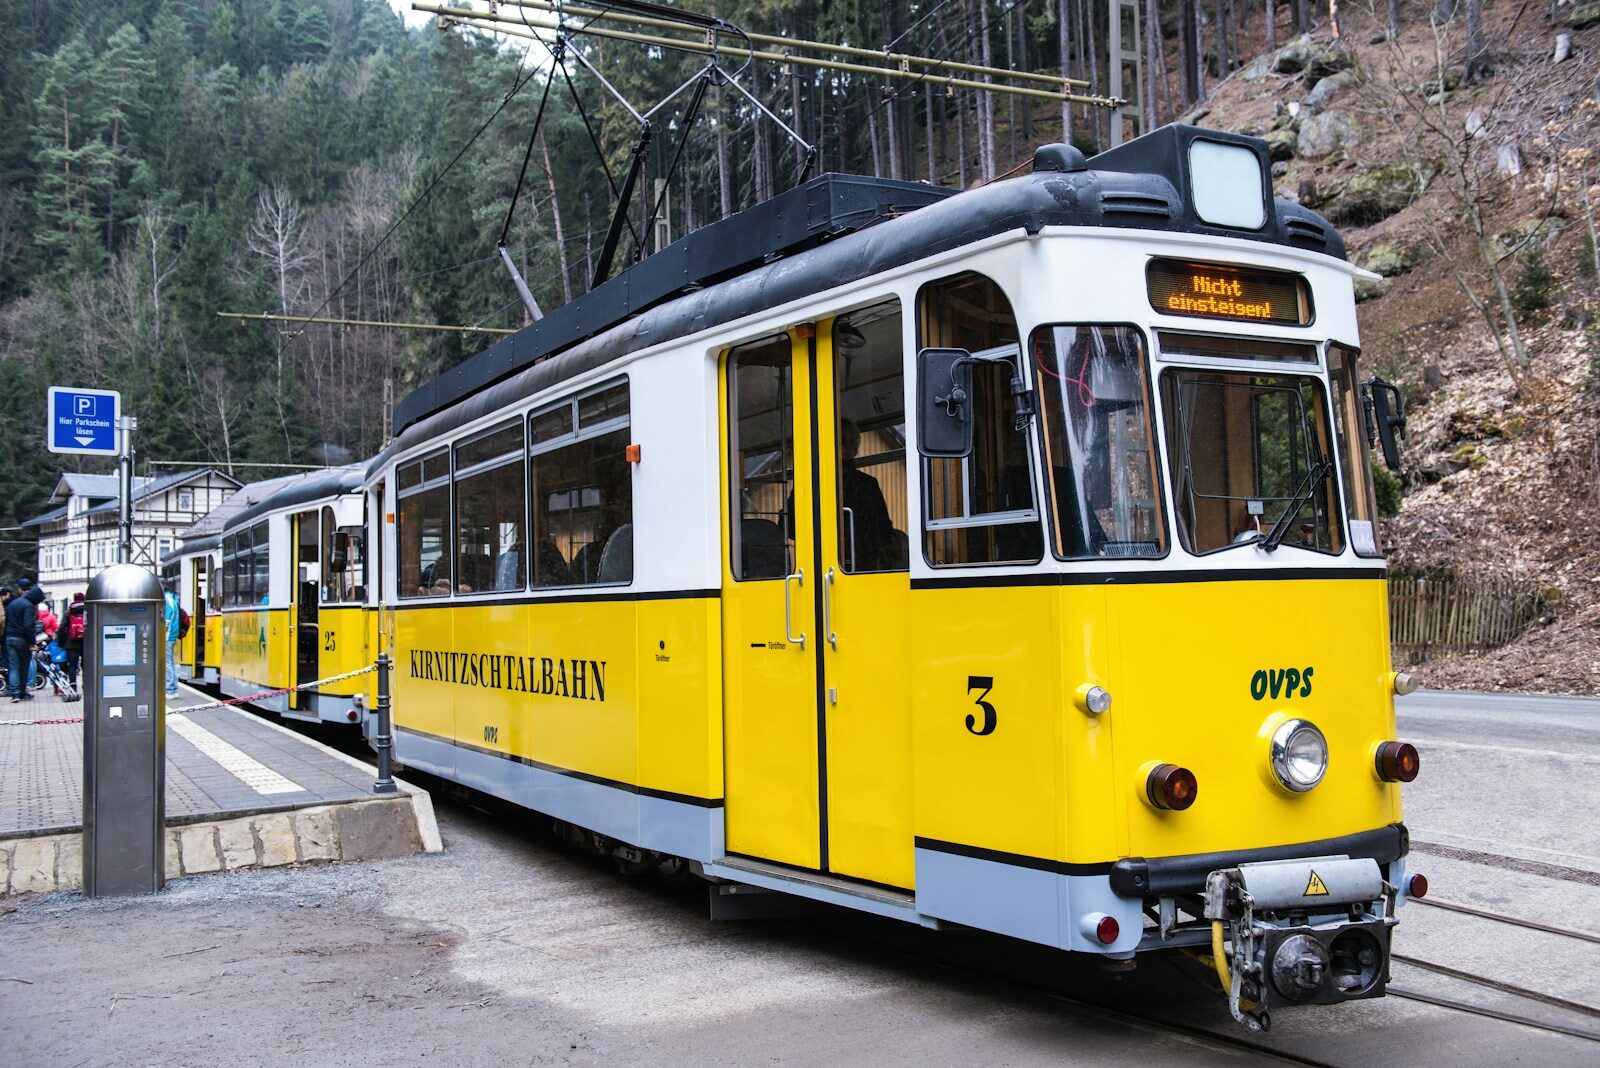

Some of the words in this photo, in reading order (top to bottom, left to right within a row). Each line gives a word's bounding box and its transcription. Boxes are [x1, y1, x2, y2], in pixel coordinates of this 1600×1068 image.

[1193, 276, 1242, 296] Nicht
[1168, 293, 1271, 318] einsteigen!
[79, 398, 91, 414] P
[59, 416, 73, 425] Hier
[75, 418, 110, 428] Parkschein
[76, 427, 94, 436] lösen
[410, 649, 607, 702] KIRNITZSCHTALBAHN
[1250, 666, 1314, 701] OVPS
[965, 675, 998, 736] 3
[483, 725, 498, 744] OVPS
